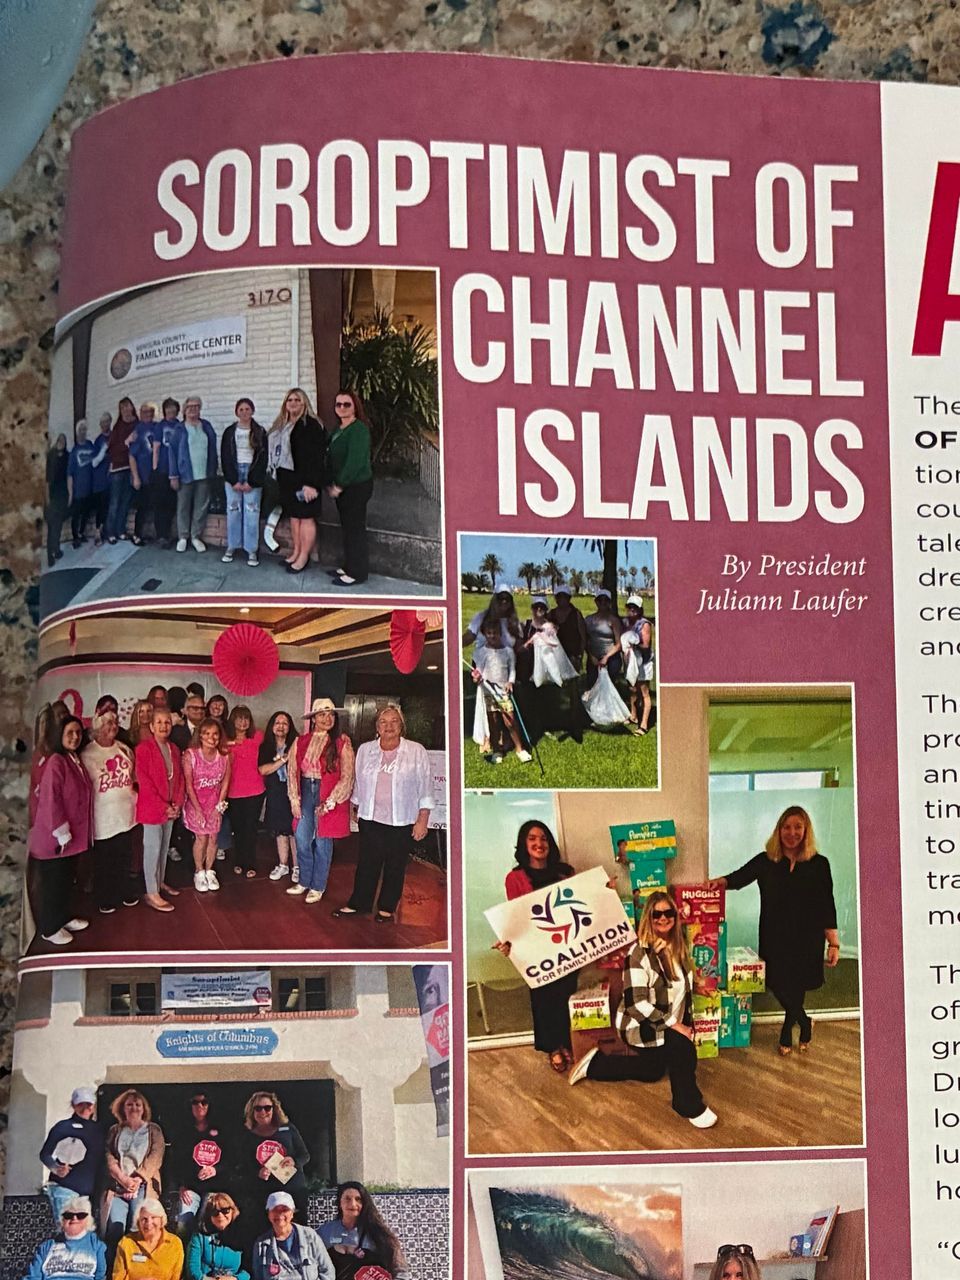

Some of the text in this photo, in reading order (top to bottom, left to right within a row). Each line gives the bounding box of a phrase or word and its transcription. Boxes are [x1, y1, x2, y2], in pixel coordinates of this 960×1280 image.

[154, 140, 858, 270] SOROPTIMIST OF
[247, 287, 292, 305] 3170
[135, 348, 164, 363] FAMILY
[165, 340, 200, 357] JUSTICE
[202, 334, 242, 350] CENTER
[452, 273, 864, 396] CHANNEL
[915, 431, 957, 449] OF
[497, 408, 864, 523] ISLANDS
[721, 553, 866, 583] By President
[697, 588, 868, 617] Juliann Laufer
[682, 890, 720, 899] HUGGIES
[525, 921, 630, 978] COALITION
[536, 935, 629, 984] FOR FAMILY HARMONY
[732, 963, 763, 973] HUGGIES
[573, 1000, 605, 1009] HUGGIES
[166, 1030, 269, 1047] Knights of Columbus
